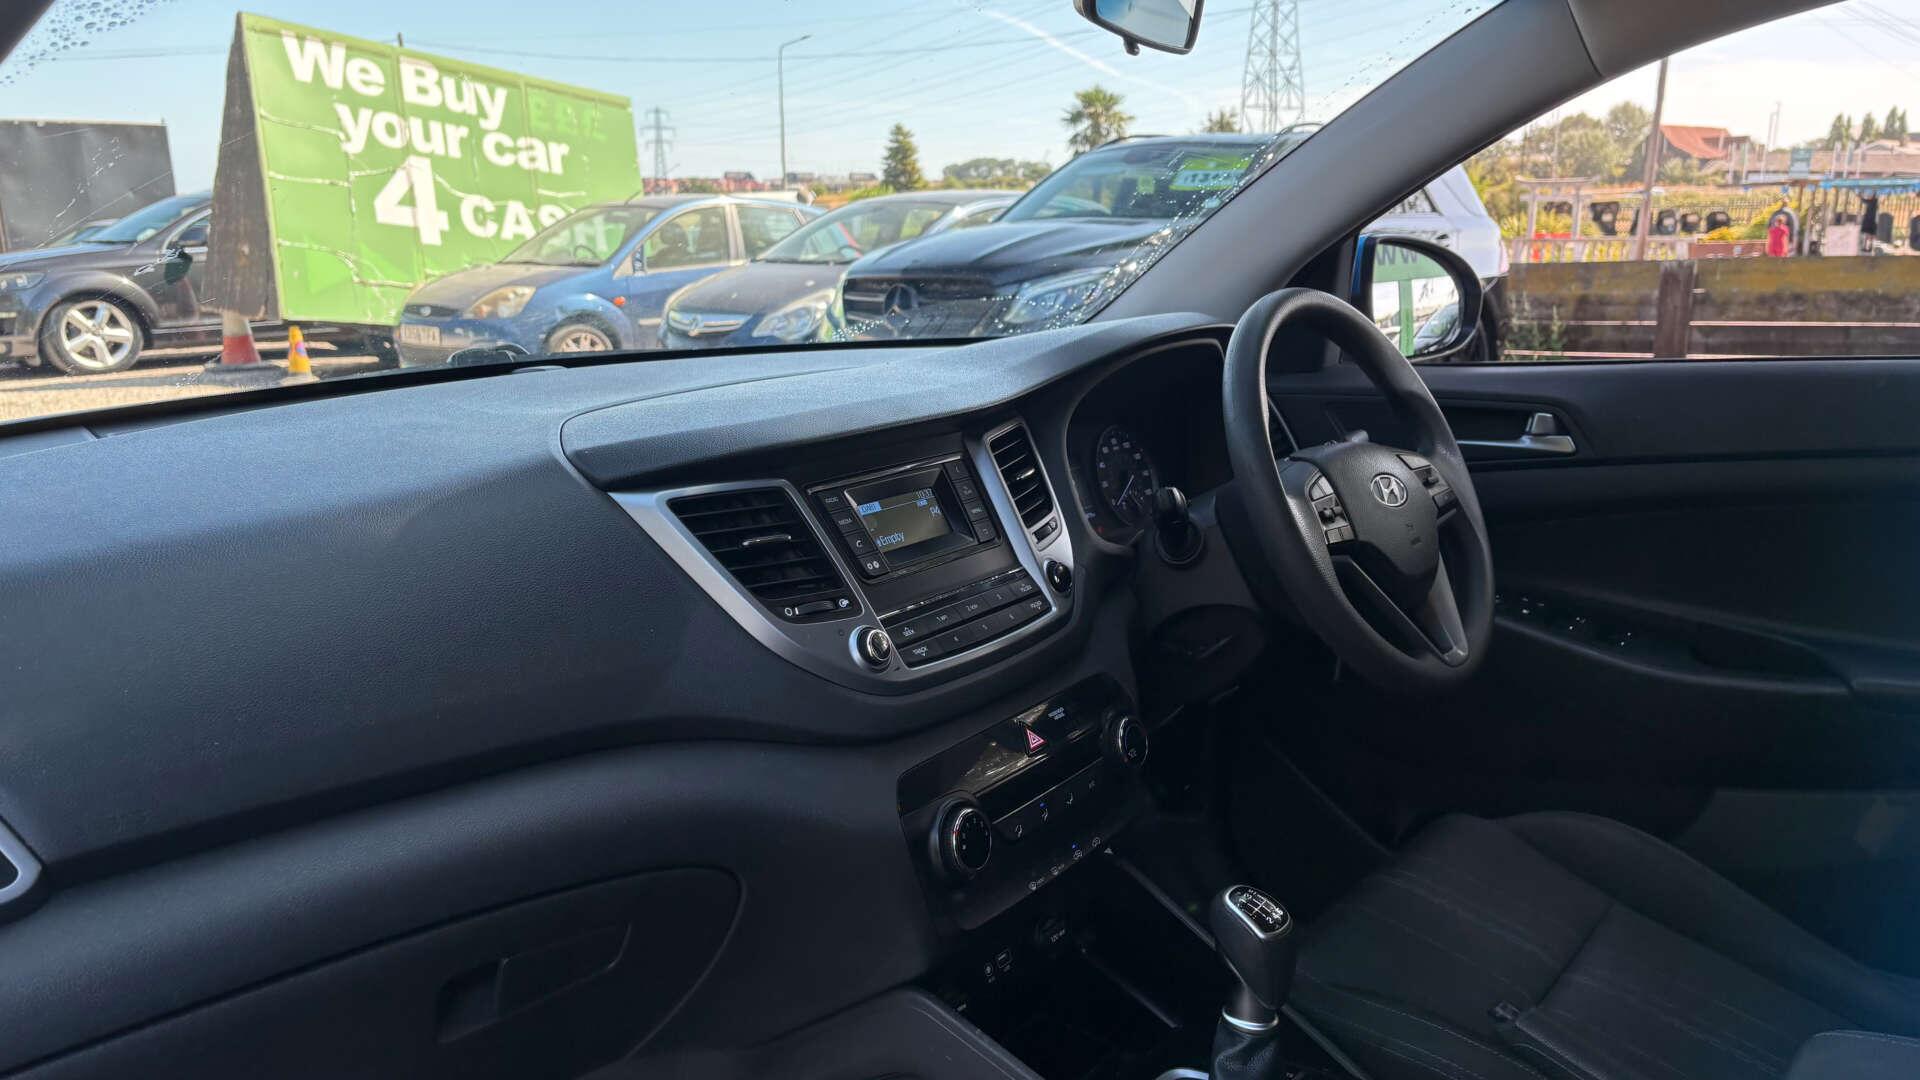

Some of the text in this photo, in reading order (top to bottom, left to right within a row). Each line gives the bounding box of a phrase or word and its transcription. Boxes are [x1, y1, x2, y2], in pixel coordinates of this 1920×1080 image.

[282, 31, 384, 96] We
[401, 57, 507, 130] Buy
[335, 103, 569, 175] your car
[375, 155, 449, 246] 4
[879, 532, 905, 547] Empty
